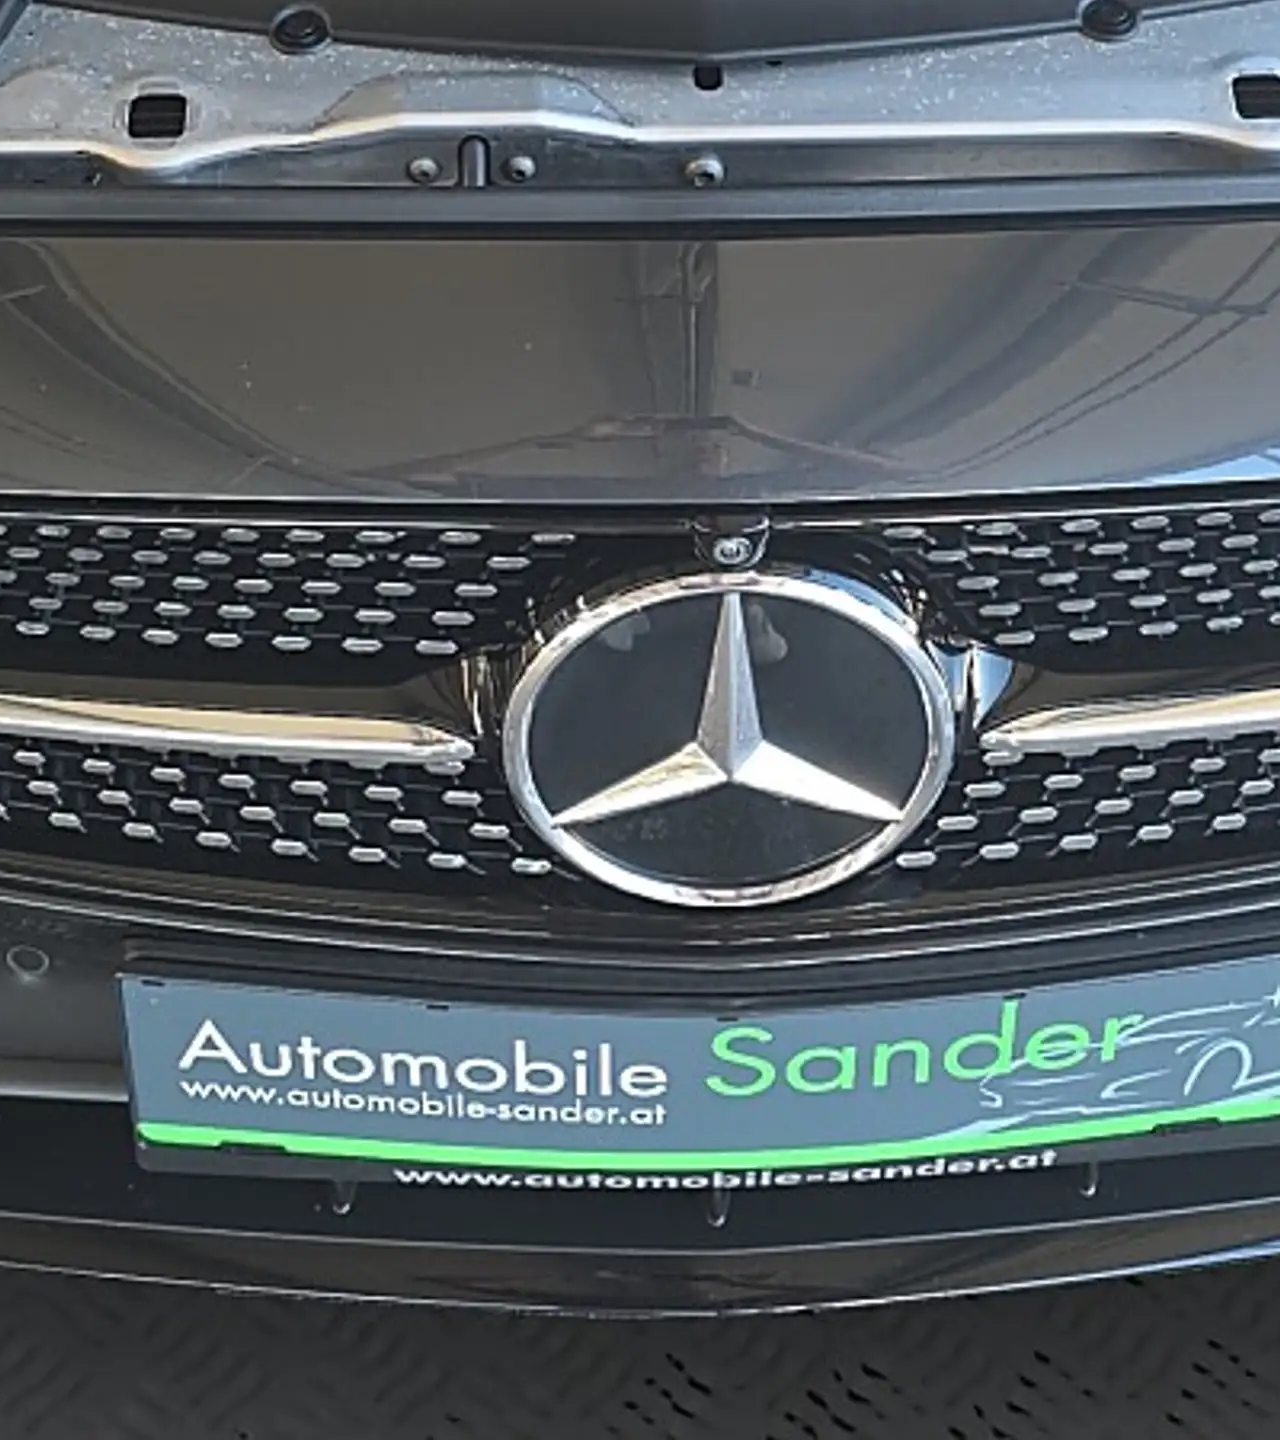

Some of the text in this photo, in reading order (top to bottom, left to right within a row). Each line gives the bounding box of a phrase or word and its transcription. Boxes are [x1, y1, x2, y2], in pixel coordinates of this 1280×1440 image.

[179, 998, 1145, 1098] Automobile Sander
[180, 1080, 667, 1127] www.automobile-sander.at
[394, 1149, 1058, 1190] www.automobile-sander.at
